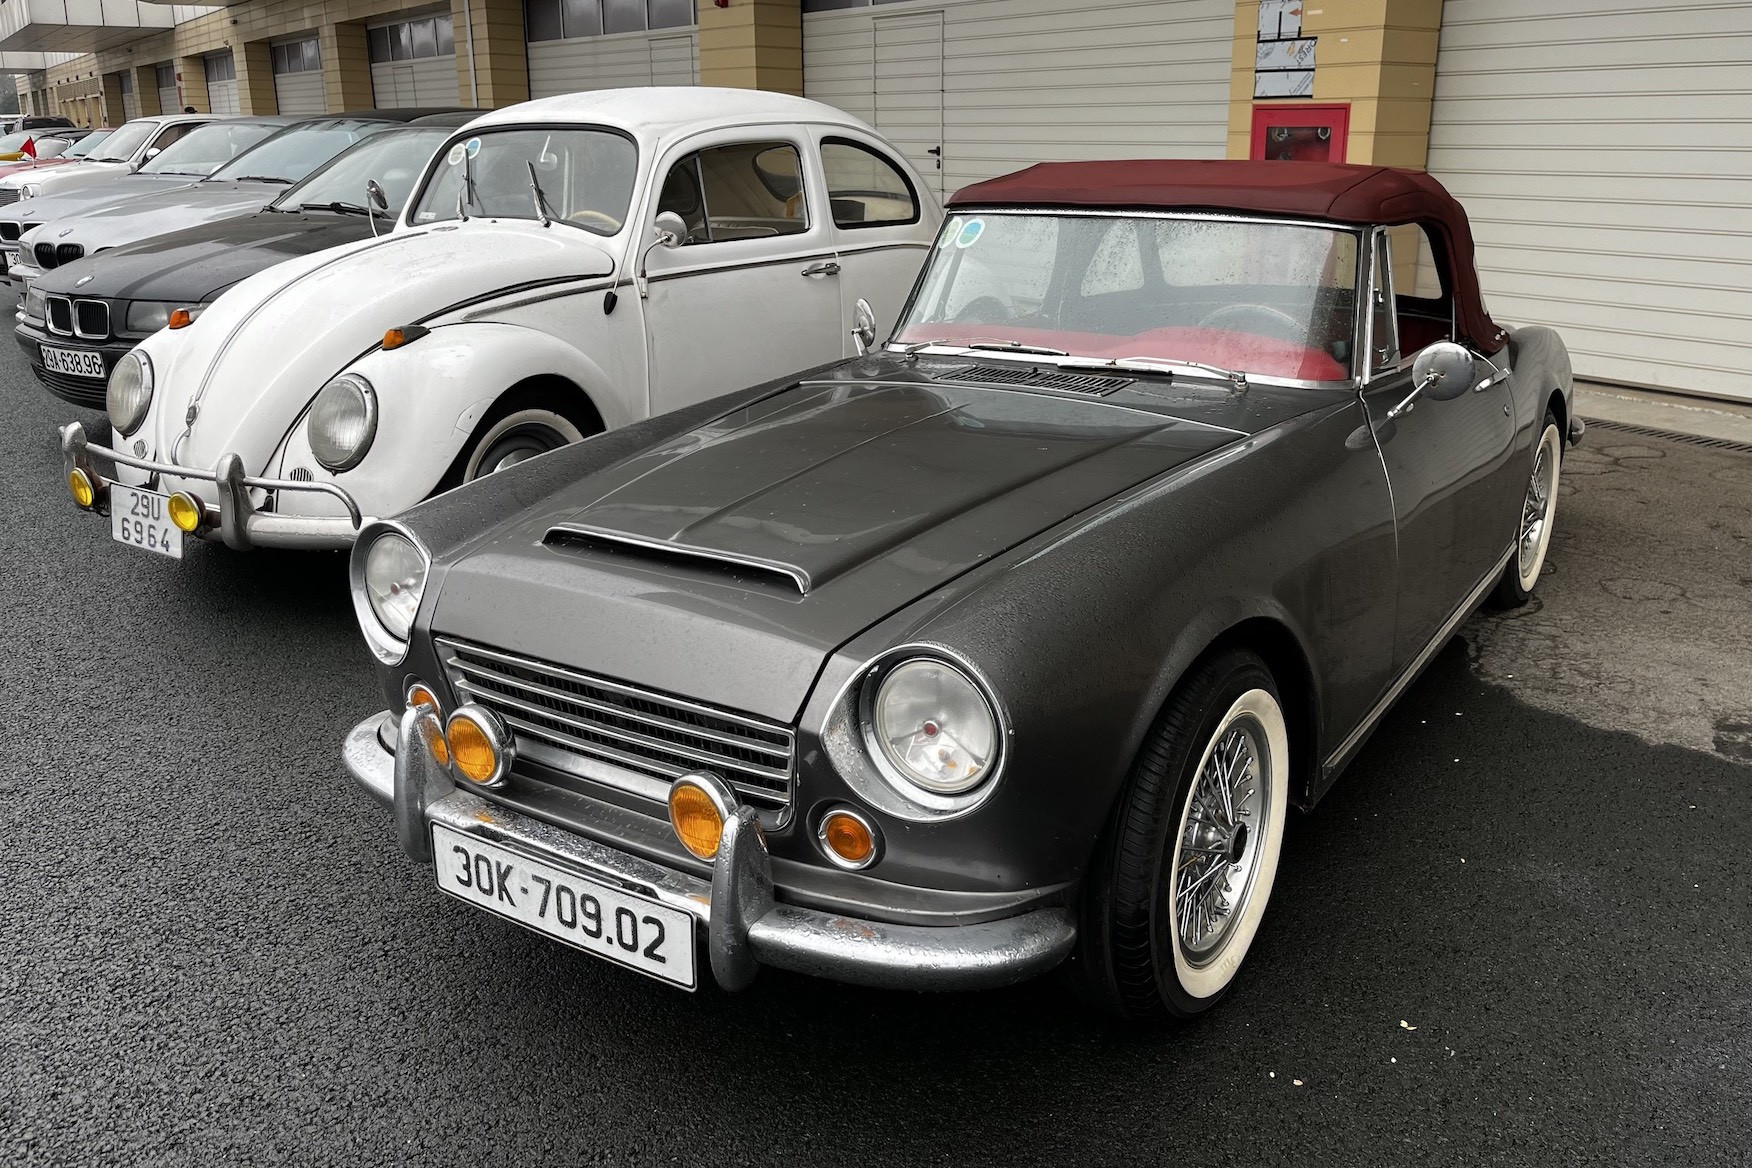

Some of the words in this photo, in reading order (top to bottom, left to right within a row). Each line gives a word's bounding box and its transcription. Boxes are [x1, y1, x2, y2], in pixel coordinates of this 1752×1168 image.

[130, 492, 160, 521] 29U
[121, 517, 170, 552] 6964
[453, 845, 667, 963] 30K-709.02
